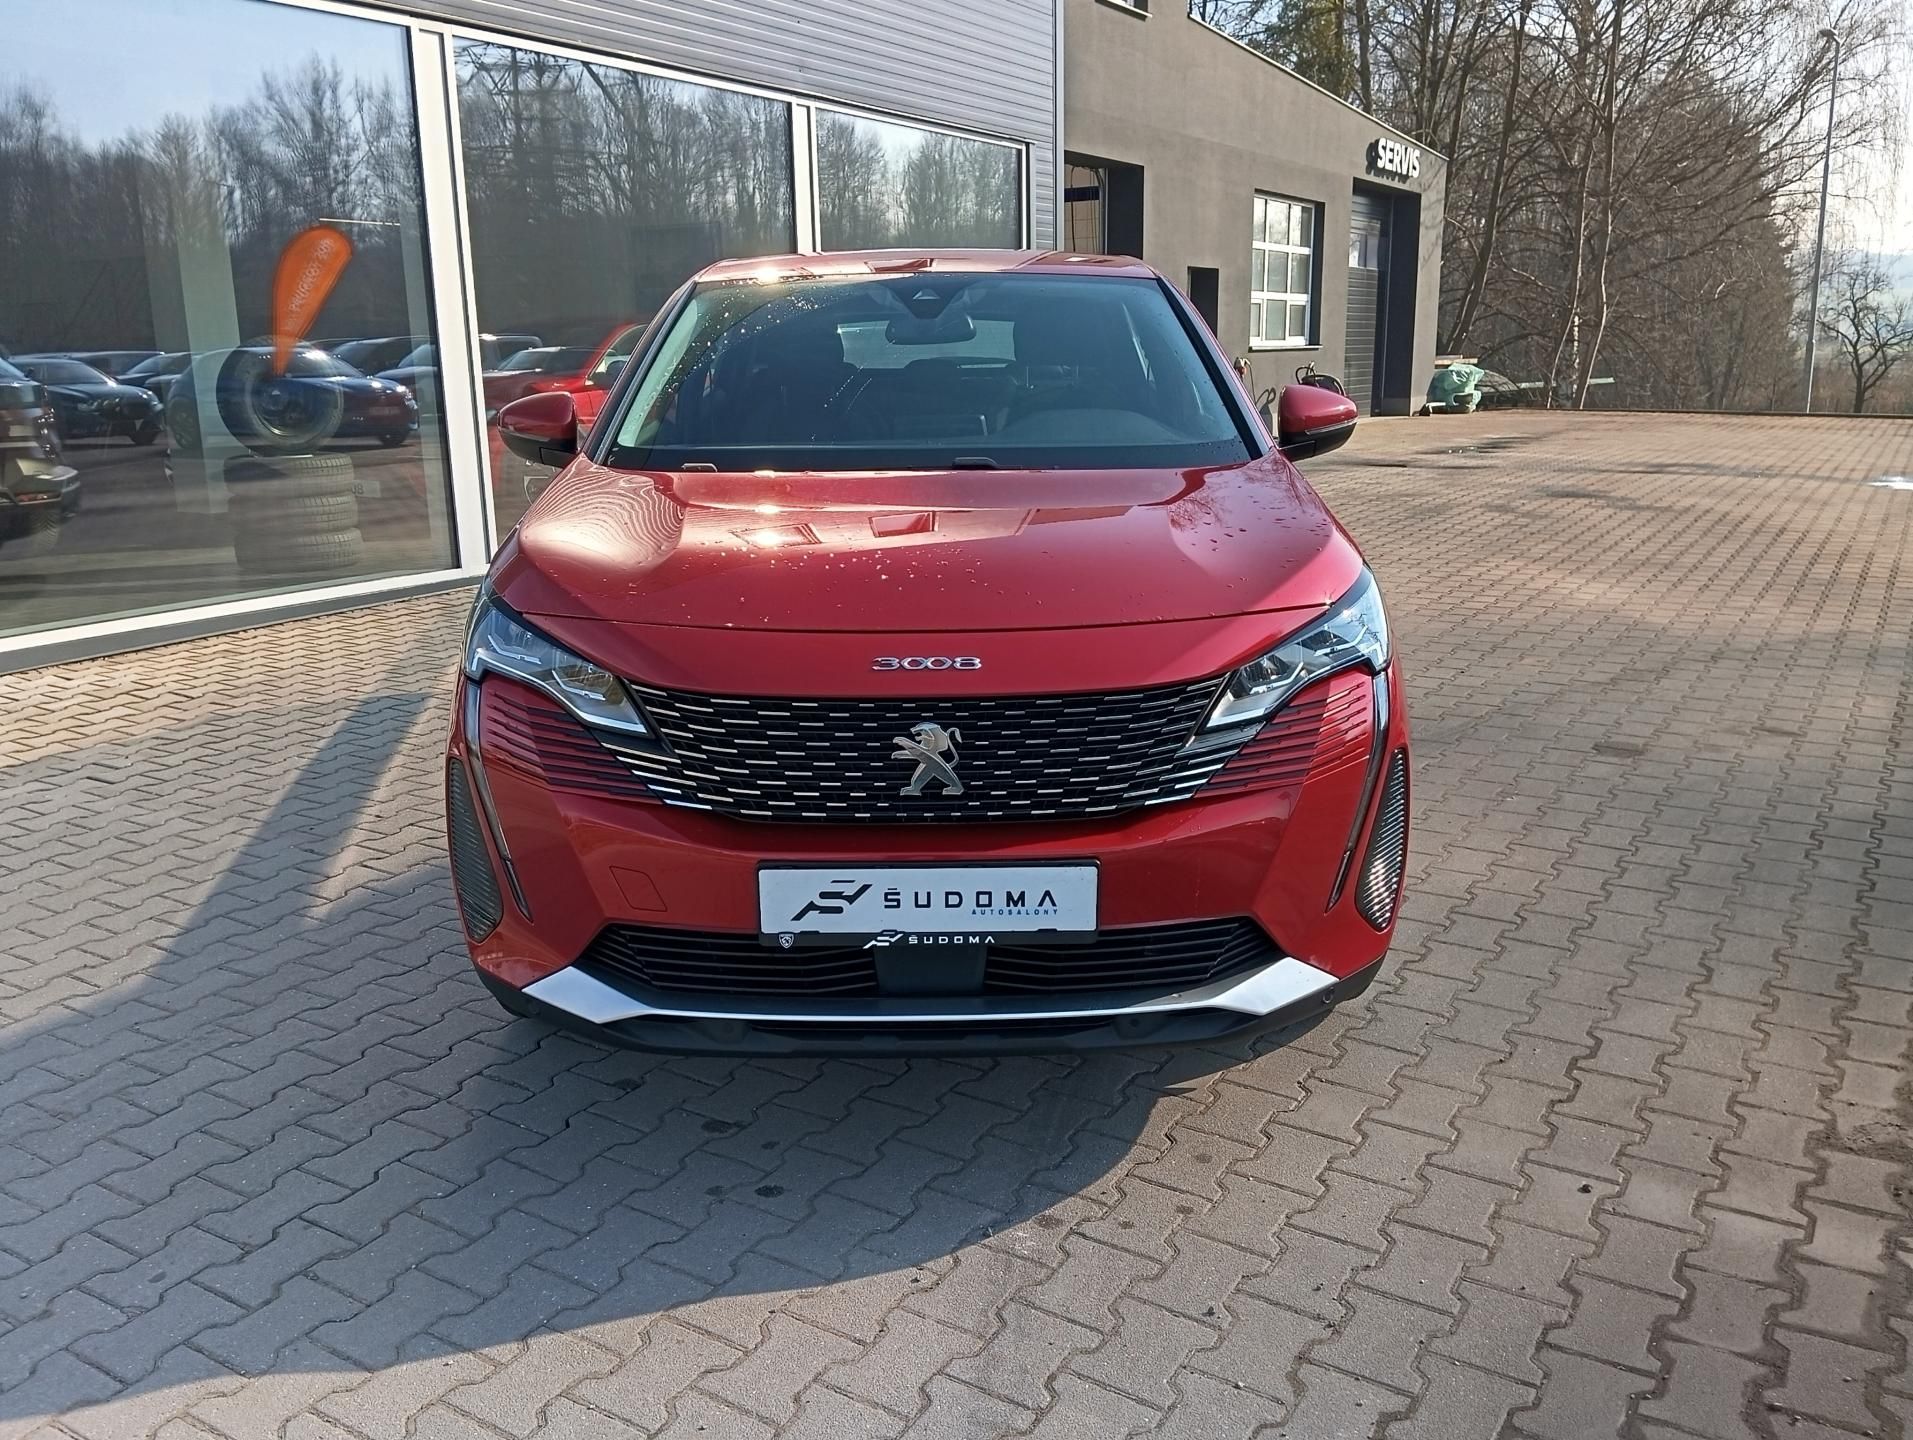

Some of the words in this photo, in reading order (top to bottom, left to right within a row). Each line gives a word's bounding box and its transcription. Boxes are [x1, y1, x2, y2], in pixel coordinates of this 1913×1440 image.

[1377, 137, 1420, 178] SERVIS
[871, 656, 982, 670] 3008
[971, 908, 1058, 916] AUTOSALONY
